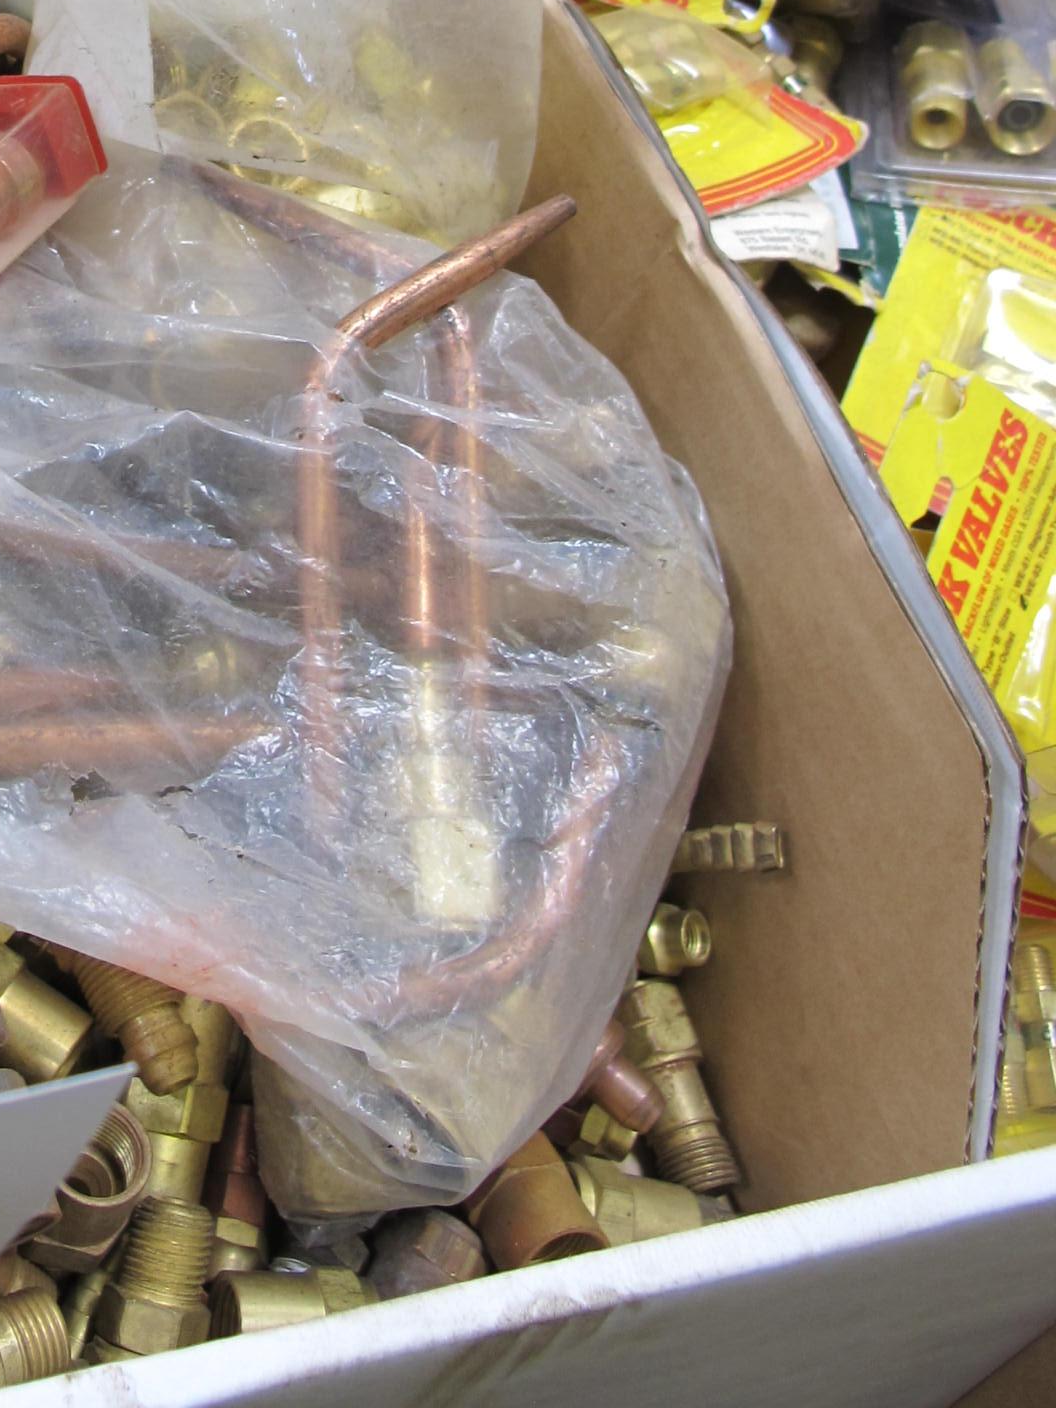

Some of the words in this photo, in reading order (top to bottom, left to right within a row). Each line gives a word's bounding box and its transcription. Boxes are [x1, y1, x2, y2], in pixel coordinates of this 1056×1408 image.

[951, 407, 1028, 570] VALVES
[986, 538, 1006, 570] MIXED
[998, 506, 1019, 538] GASES
[1026, 431, 1048, 466] TESTED
